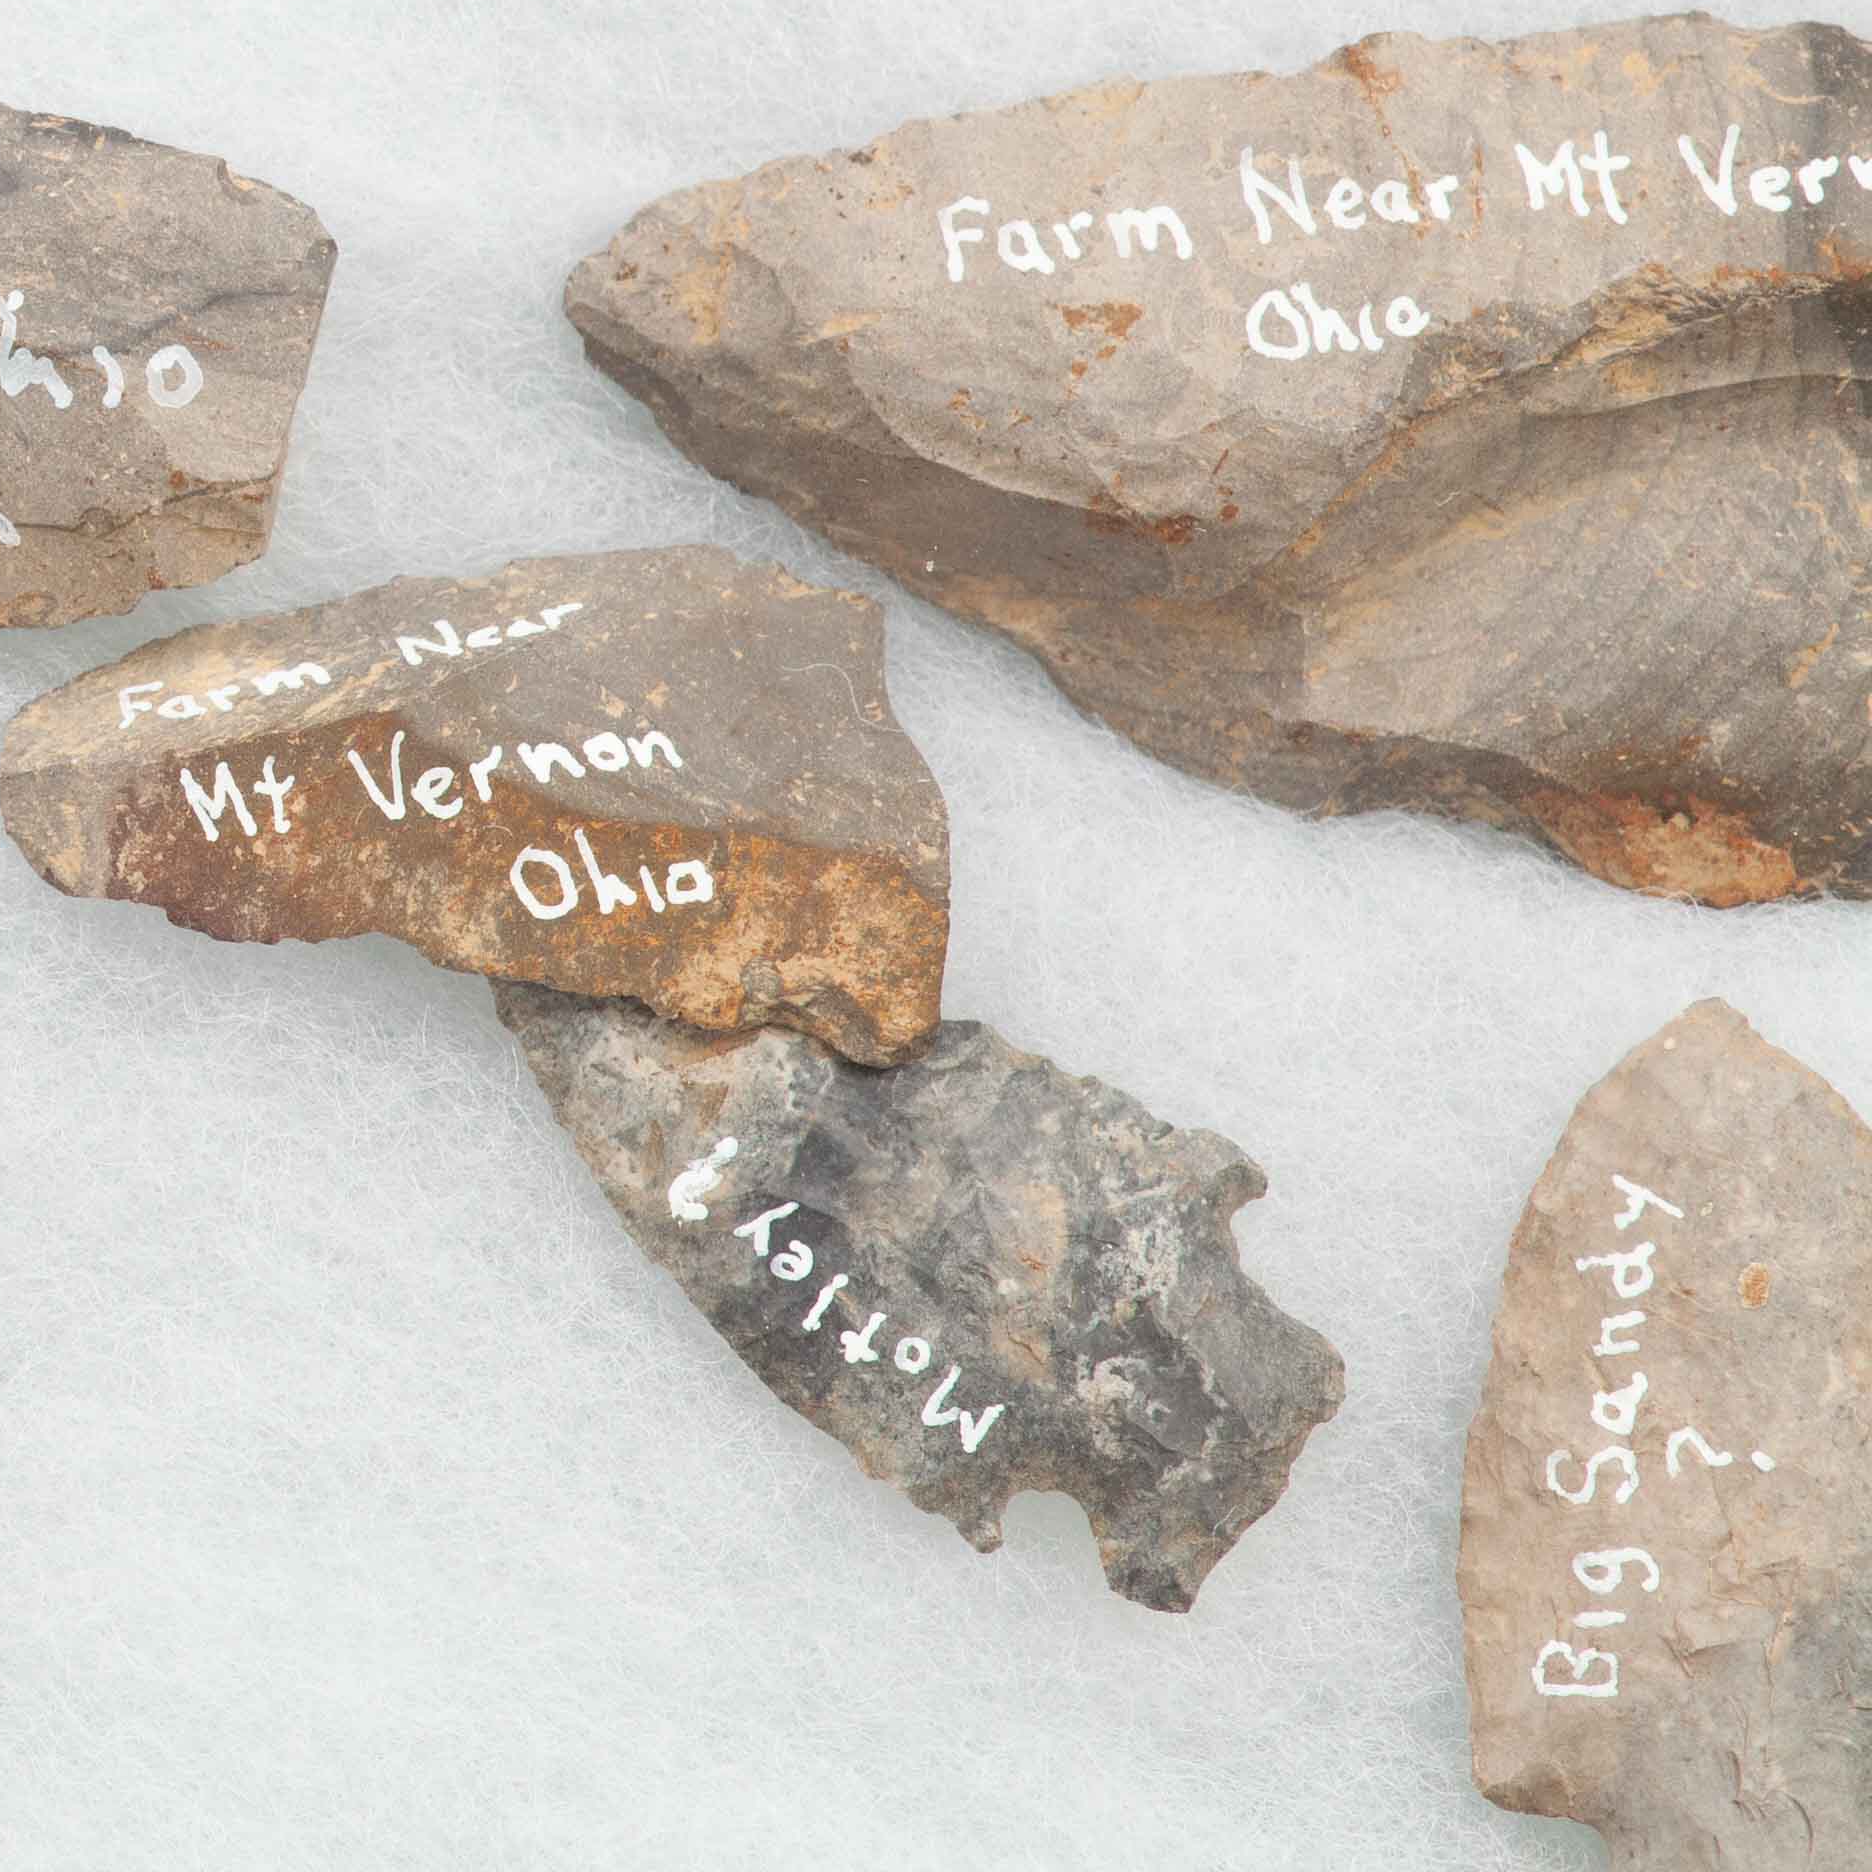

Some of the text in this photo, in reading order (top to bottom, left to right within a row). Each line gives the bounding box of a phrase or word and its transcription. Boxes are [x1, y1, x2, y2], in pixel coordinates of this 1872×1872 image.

[938, 194, 1194, 283] Farm
[1239, 145, 1459, 244] Near
[1514, 129, 1631, 225] Mt
[1246, 282, 1431, 362] Ohio
[118, 602, 584, 729] Farm Near
[180, 730, 683, 841] Mt Vernon
[509, 828, 716, 920] Ohio
[733, 1200, 1006, 1454] Motley
[1531, 1173, 1685, 1698] Big Sandy
[1666, 1425, 1776, 1481] ?
